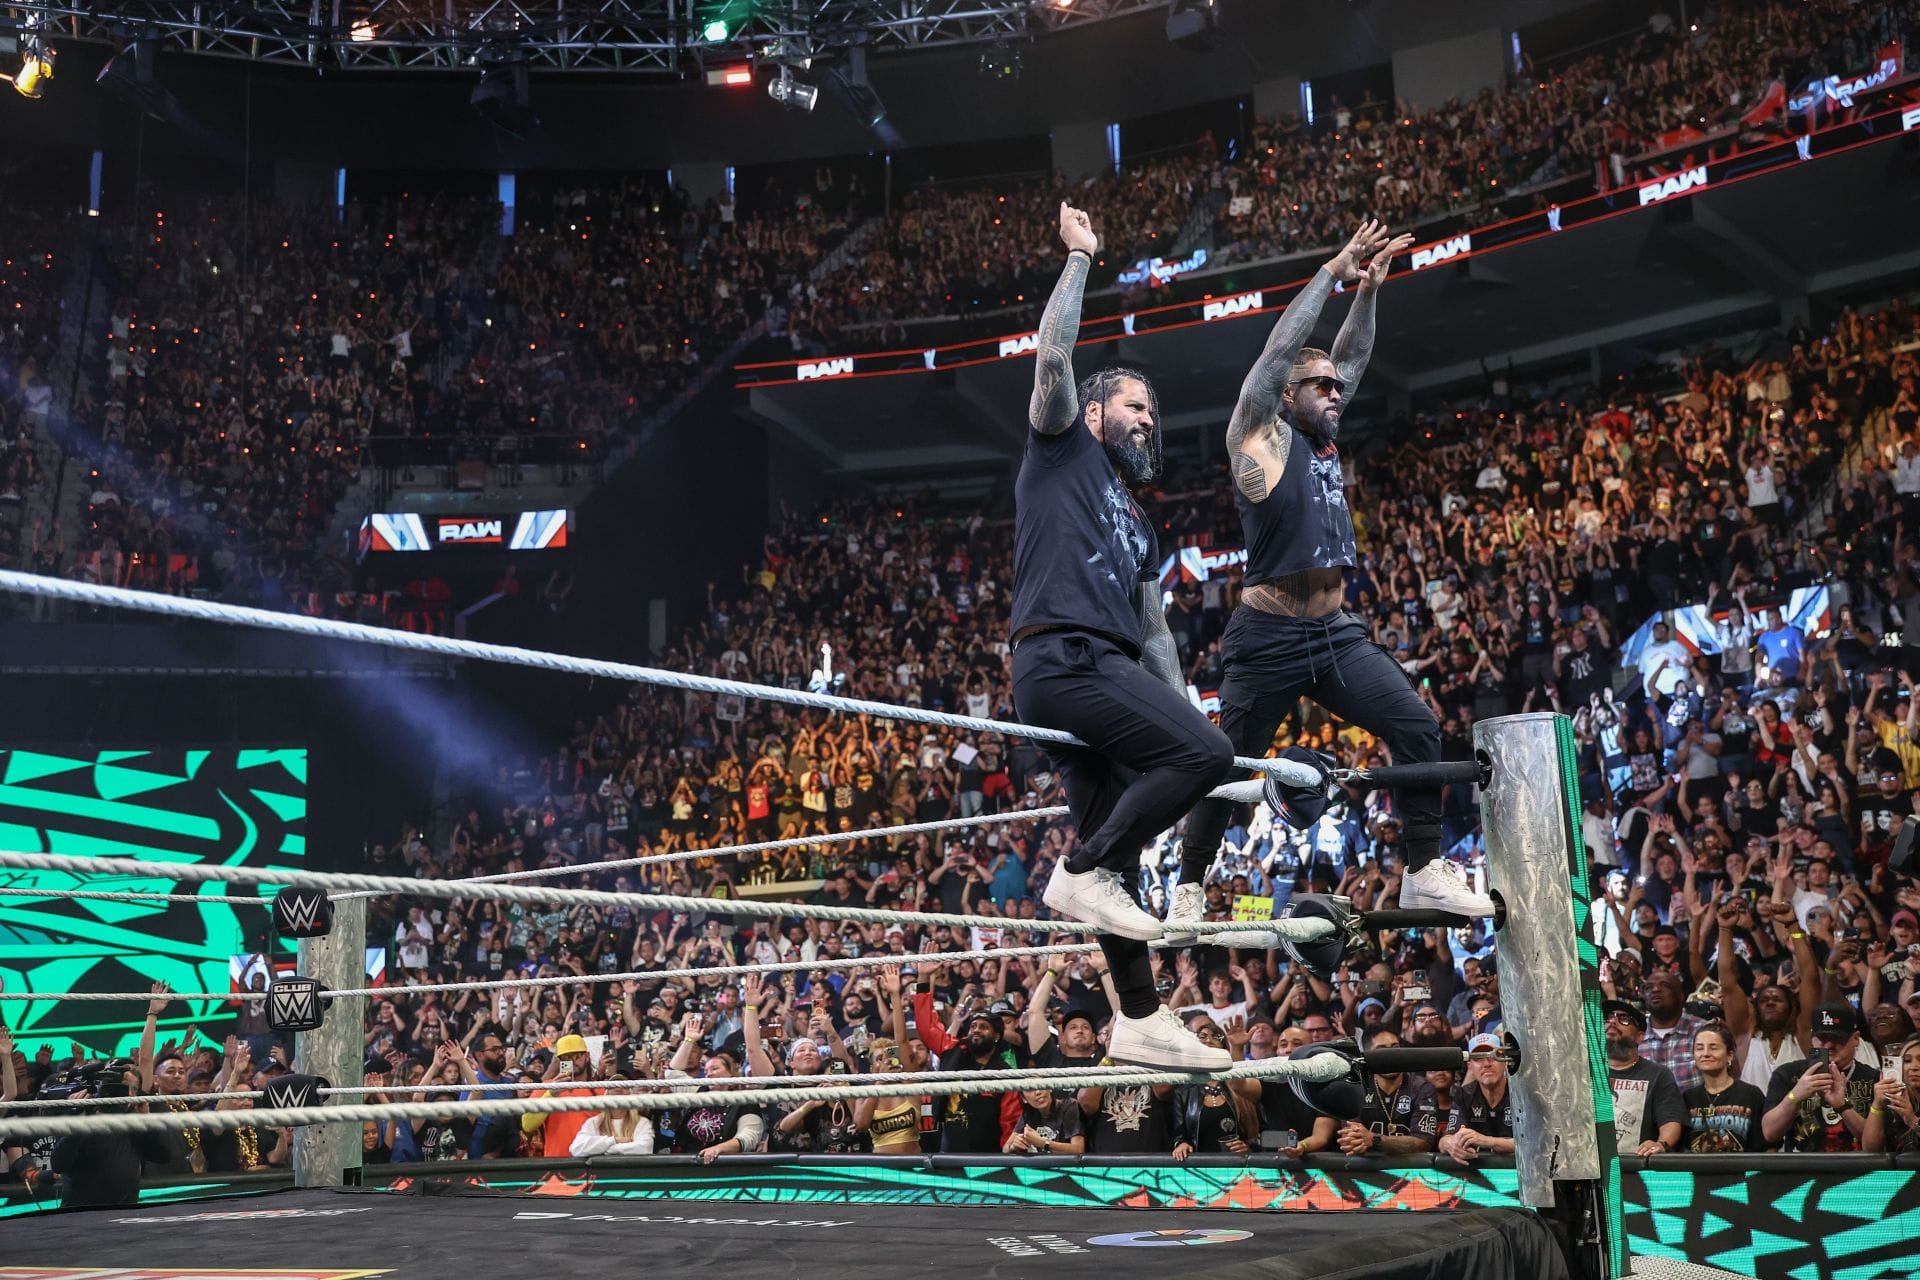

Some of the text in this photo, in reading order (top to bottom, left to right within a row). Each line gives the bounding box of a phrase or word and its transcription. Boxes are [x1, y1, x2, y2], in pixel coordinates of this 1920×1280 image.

[1639, 165, 1707, 206] RAW
[1411, 234, 1471, 271] RAW
[1203, 291, 1262, 321] RAW
[797, 357, 853, 381] RAW
[439, 520, 501, 542] RAW
[274, 984, 312, 993] CLUB
[1821, 1010, 1835, 1026] LA
[1614, 1080, 1648, 1093] HEAT
[871, 1113, 914, 1134] CAUTION
